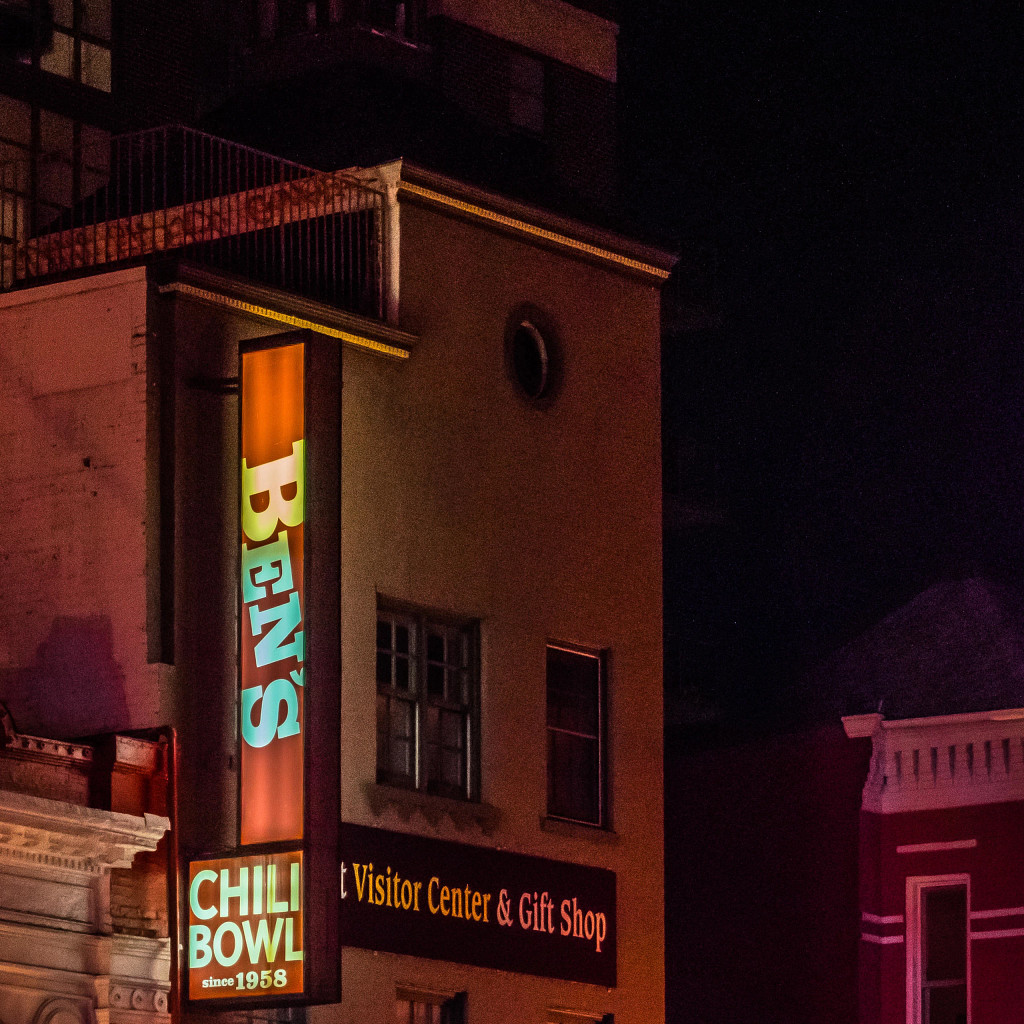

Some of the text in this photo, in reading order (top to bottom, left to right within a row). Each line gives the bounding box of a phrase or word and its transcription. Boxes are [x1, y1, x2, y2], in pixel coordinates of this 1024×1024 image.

[241, 439, 305, 748] BEN'S
[190, 862, 300, 920] CHILI
[352, 862, 422, 912] Visitor
[427, 877, 491, 923] Center
[496, 888, 514, 927] &
[518, 891, 555, 934] Gift
[560, 897, 607, 952] Shop
[189, 917, 303, 968] BOWL
[202, 969, 288, 990] since 1958
